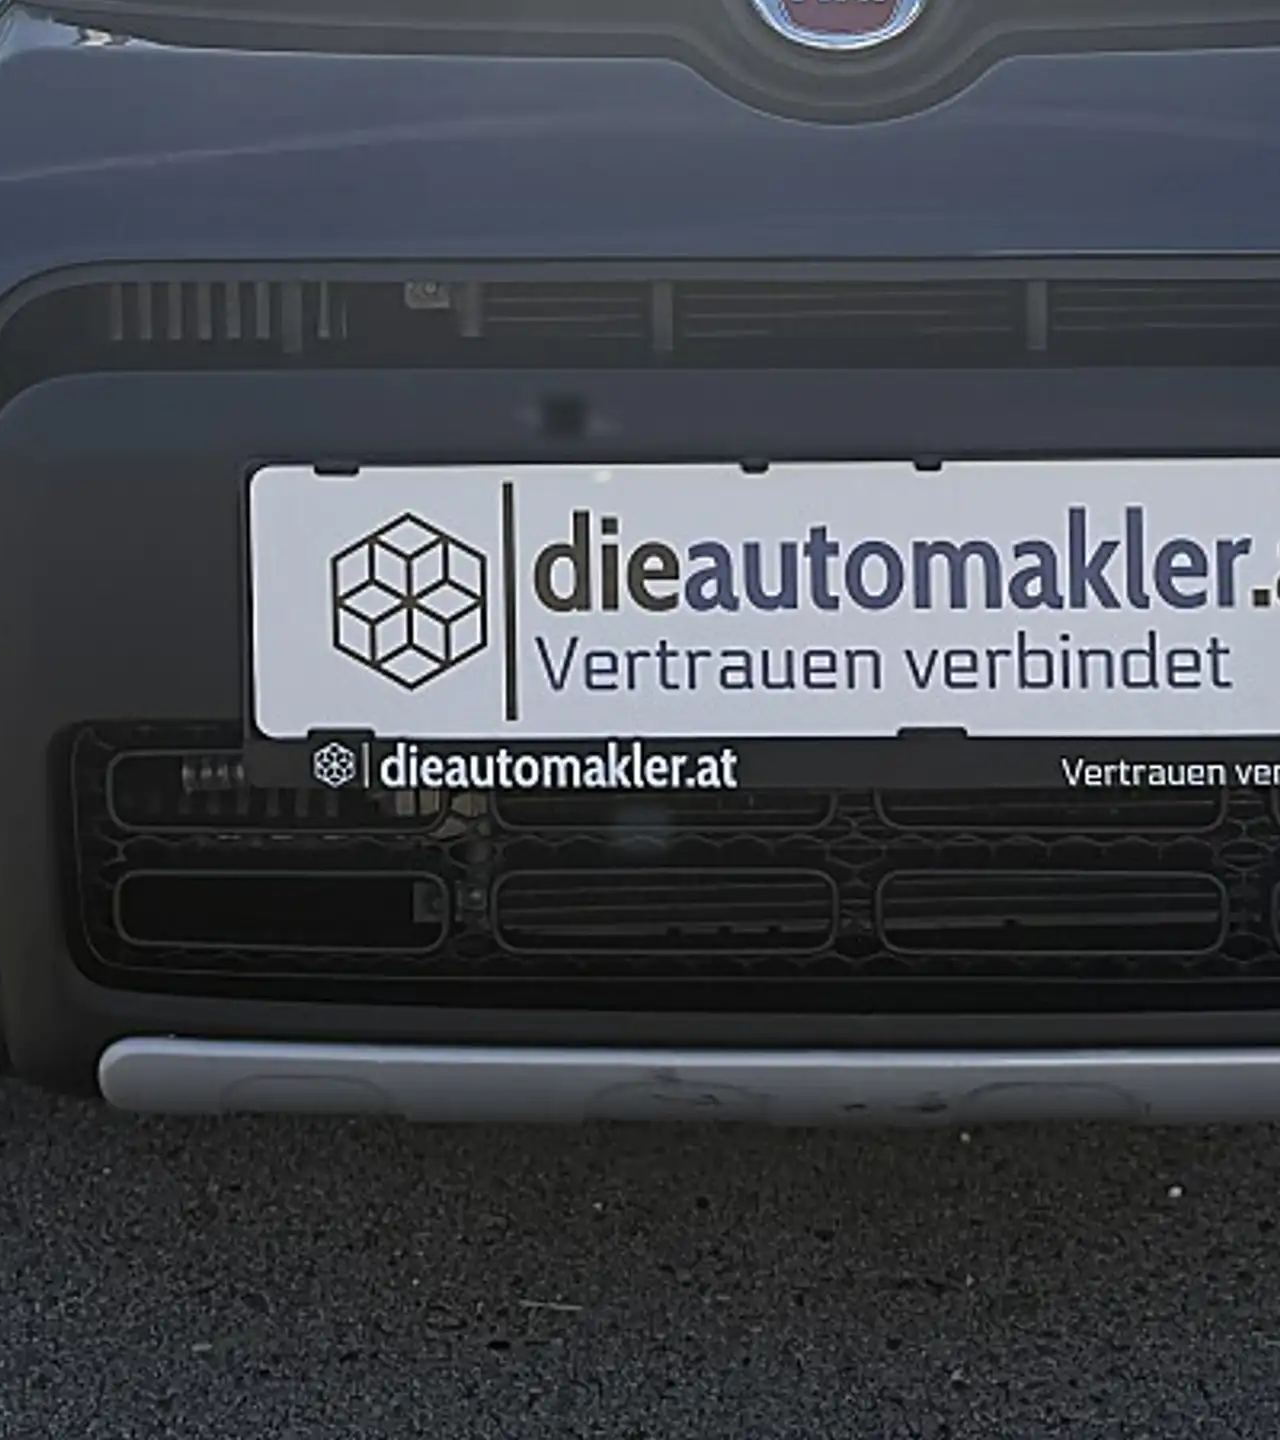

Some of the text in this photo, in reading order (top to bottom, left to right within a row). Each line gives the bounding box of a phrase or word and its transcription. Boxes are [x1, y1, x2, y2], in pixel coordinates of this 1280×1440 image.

[536, 630, 1233, 692] Vertrauen verbindet
[380, 742, 737, 789] dieautomakler.at
[1061, 756, 1225, 787] Vertrauen
